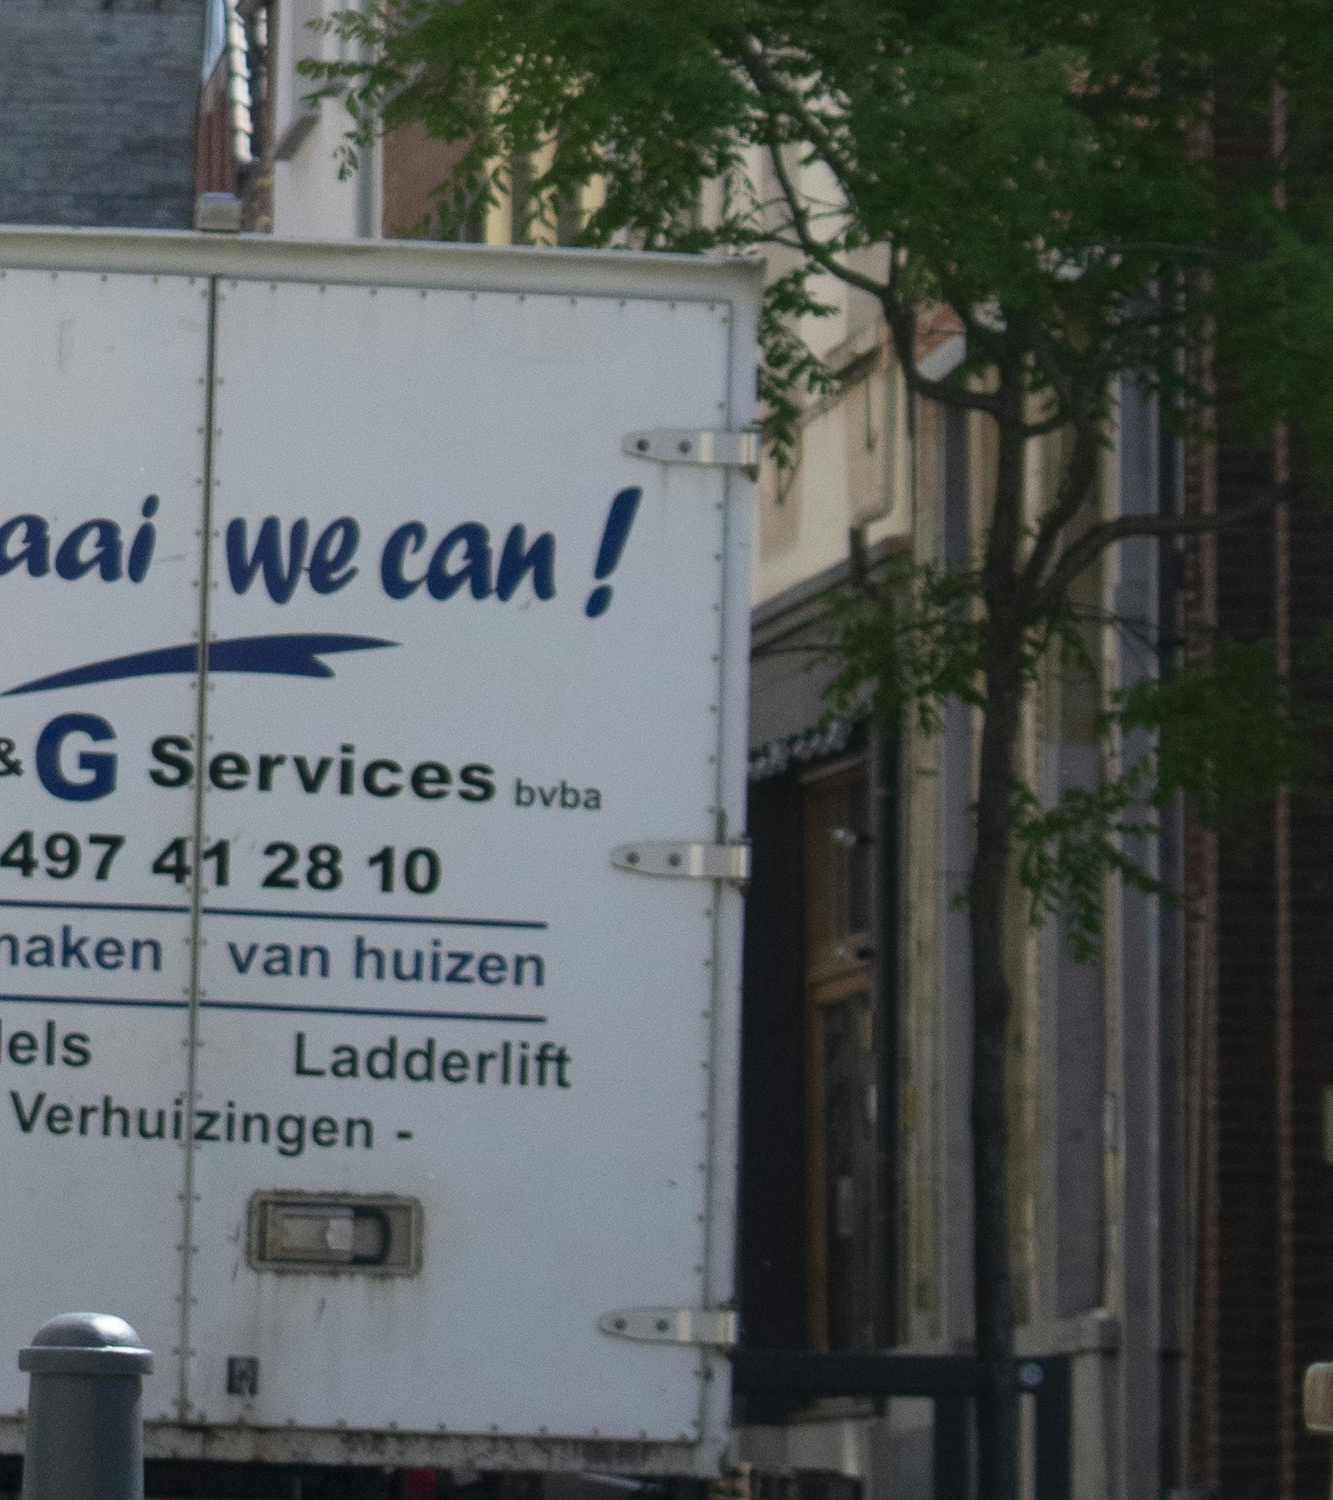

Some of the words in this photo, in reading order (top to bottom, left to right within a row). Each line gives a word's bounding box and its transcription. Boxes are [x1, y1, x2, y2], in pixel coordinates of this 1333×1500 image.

[224, 515, 361, 606] we
[148, 734, 496, 804] Services
[513, 778, 602, 812] bvba
[151, 836, 231, 888] 41
[260, 841, 343, 892] 28
[367, 846, 441, 896] 10
[226, 940, 331, 978] van
[353, 936, 546, 988] huizen
[293, 1032, 572, 1090] Ladderlift
[9, 1090, 374, 1158] Verhuizingen
